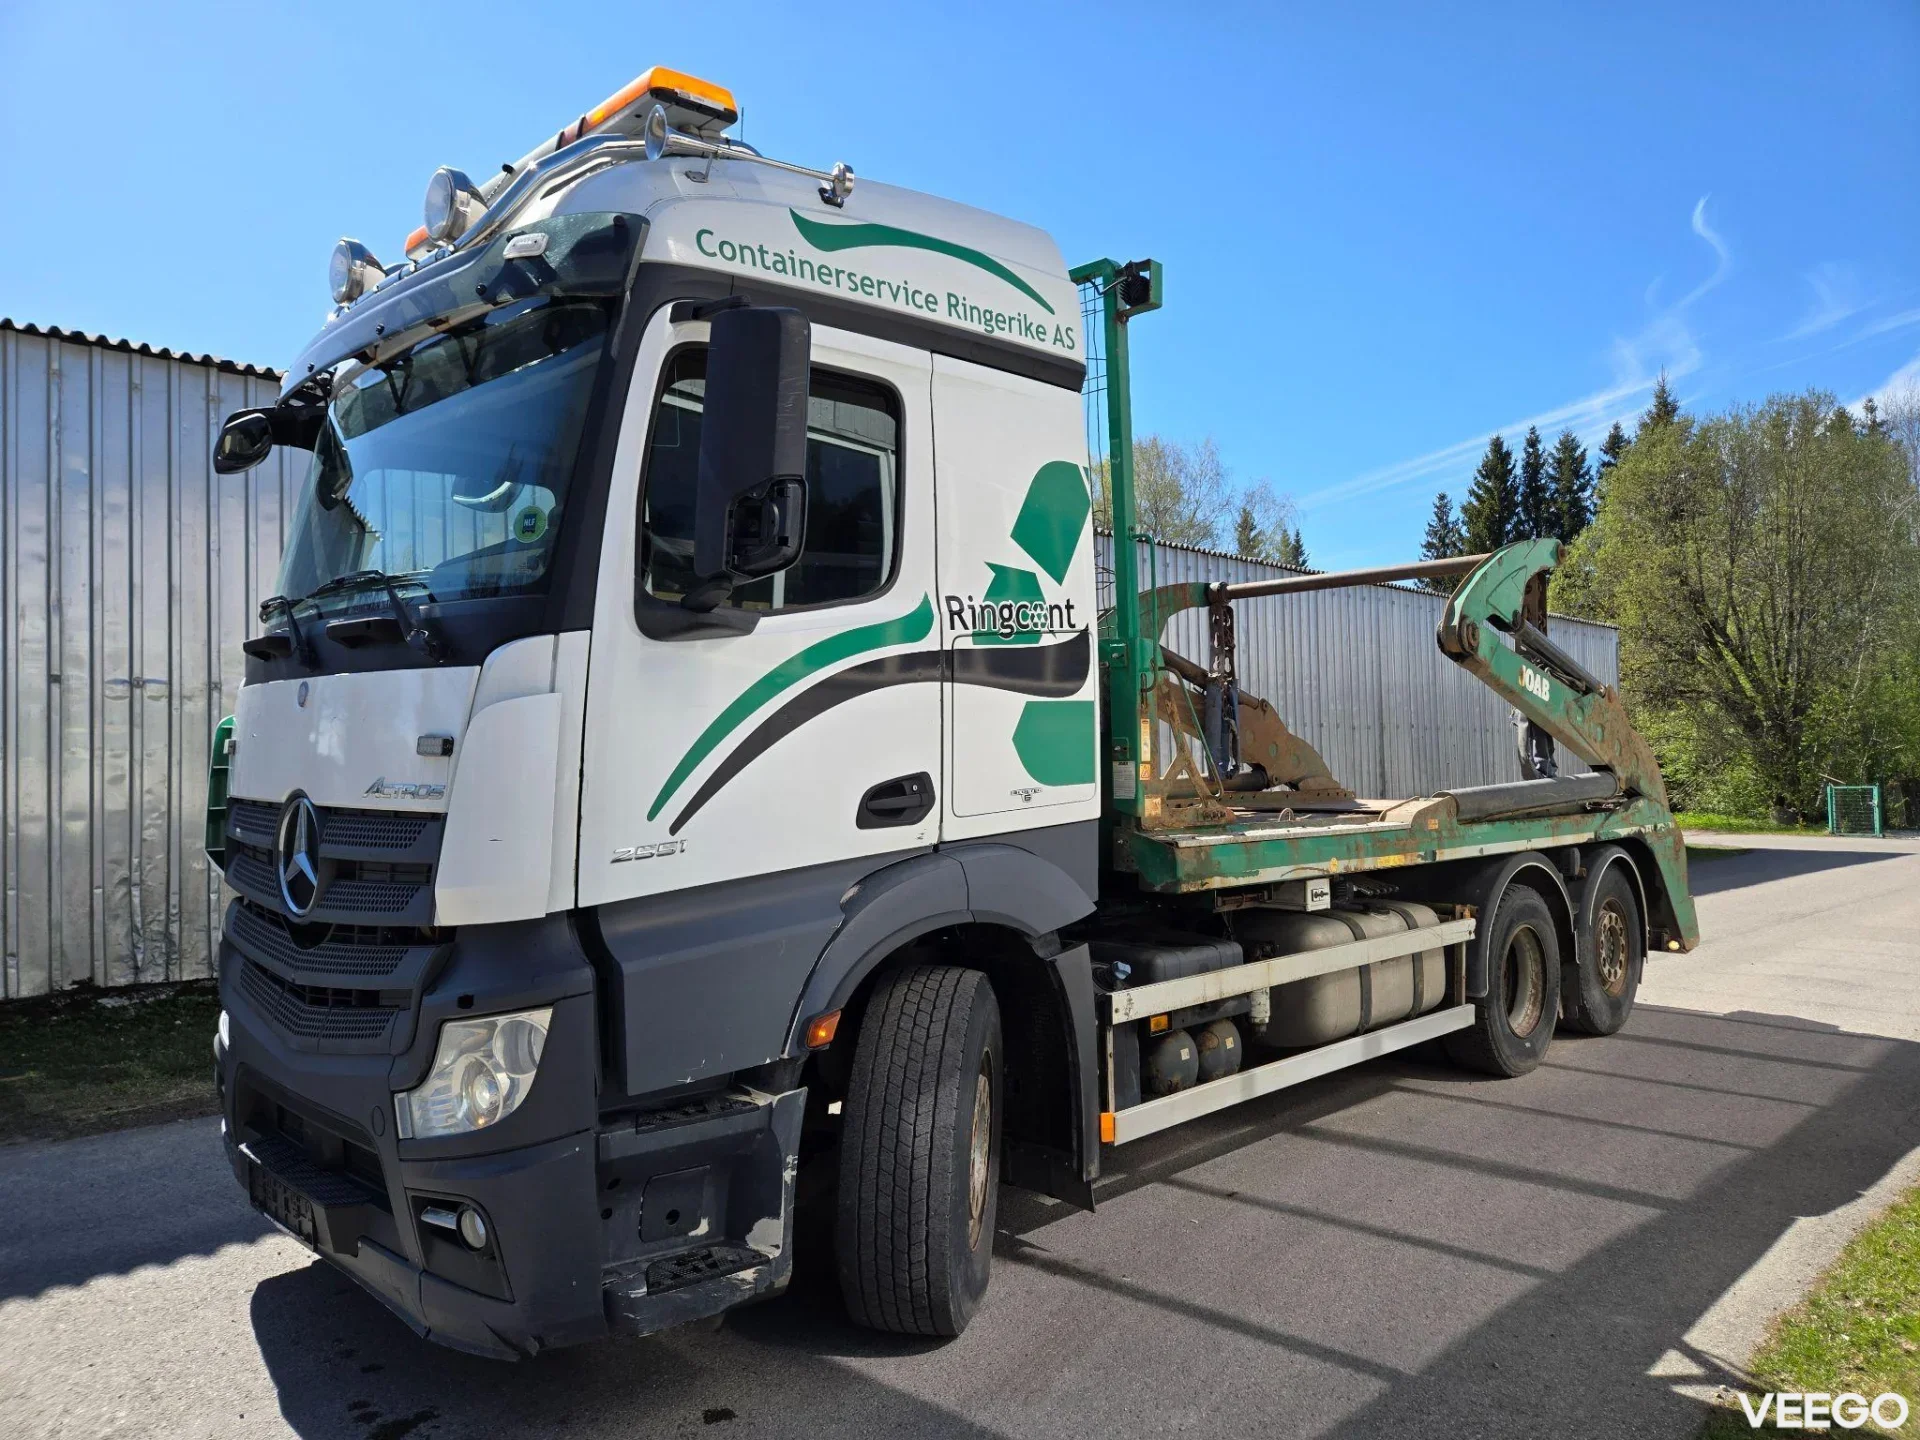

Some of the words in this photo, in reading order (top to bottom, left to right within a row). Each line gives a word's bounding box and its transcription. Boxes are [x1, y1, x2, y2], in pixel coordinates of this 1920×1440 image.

[696, 228, 938, 312] Containerservice
[947, 292, 1047, 342] Ringerike
[1053, 325, 1075, 350] AS
[944, 595, 1076, 639] Ringcont
[1518, 665, 1549, 702] JOAB
[610, 839, 688, 864] 2551
